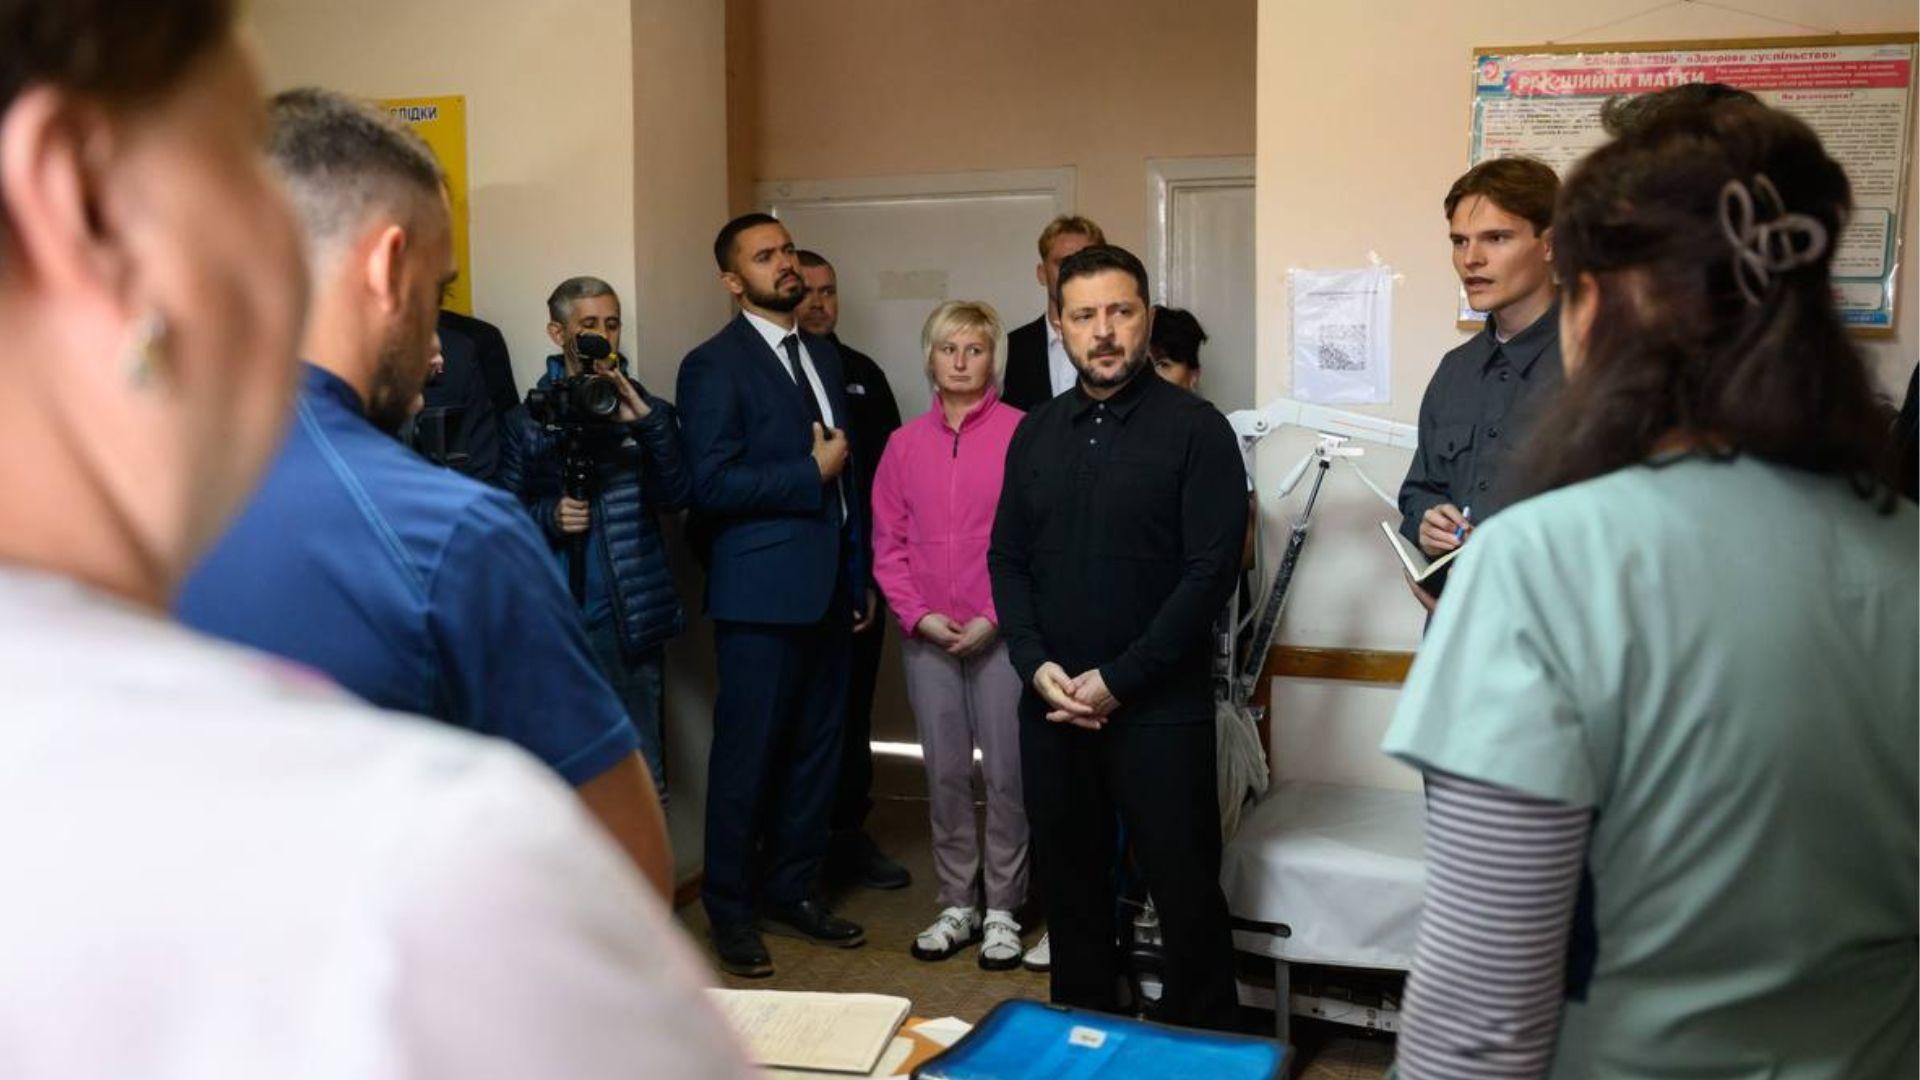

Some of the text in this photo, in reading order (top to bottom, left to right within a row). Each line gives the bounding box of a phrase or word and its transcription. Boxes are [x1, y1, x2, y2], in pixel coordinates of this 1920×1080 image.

[1585, 54, 1678, 65] САНЮТЕНЬ
[1638, 70, 1706, 88] МАТКИ
[389, 106, 438, 122] СЛІДКИ
